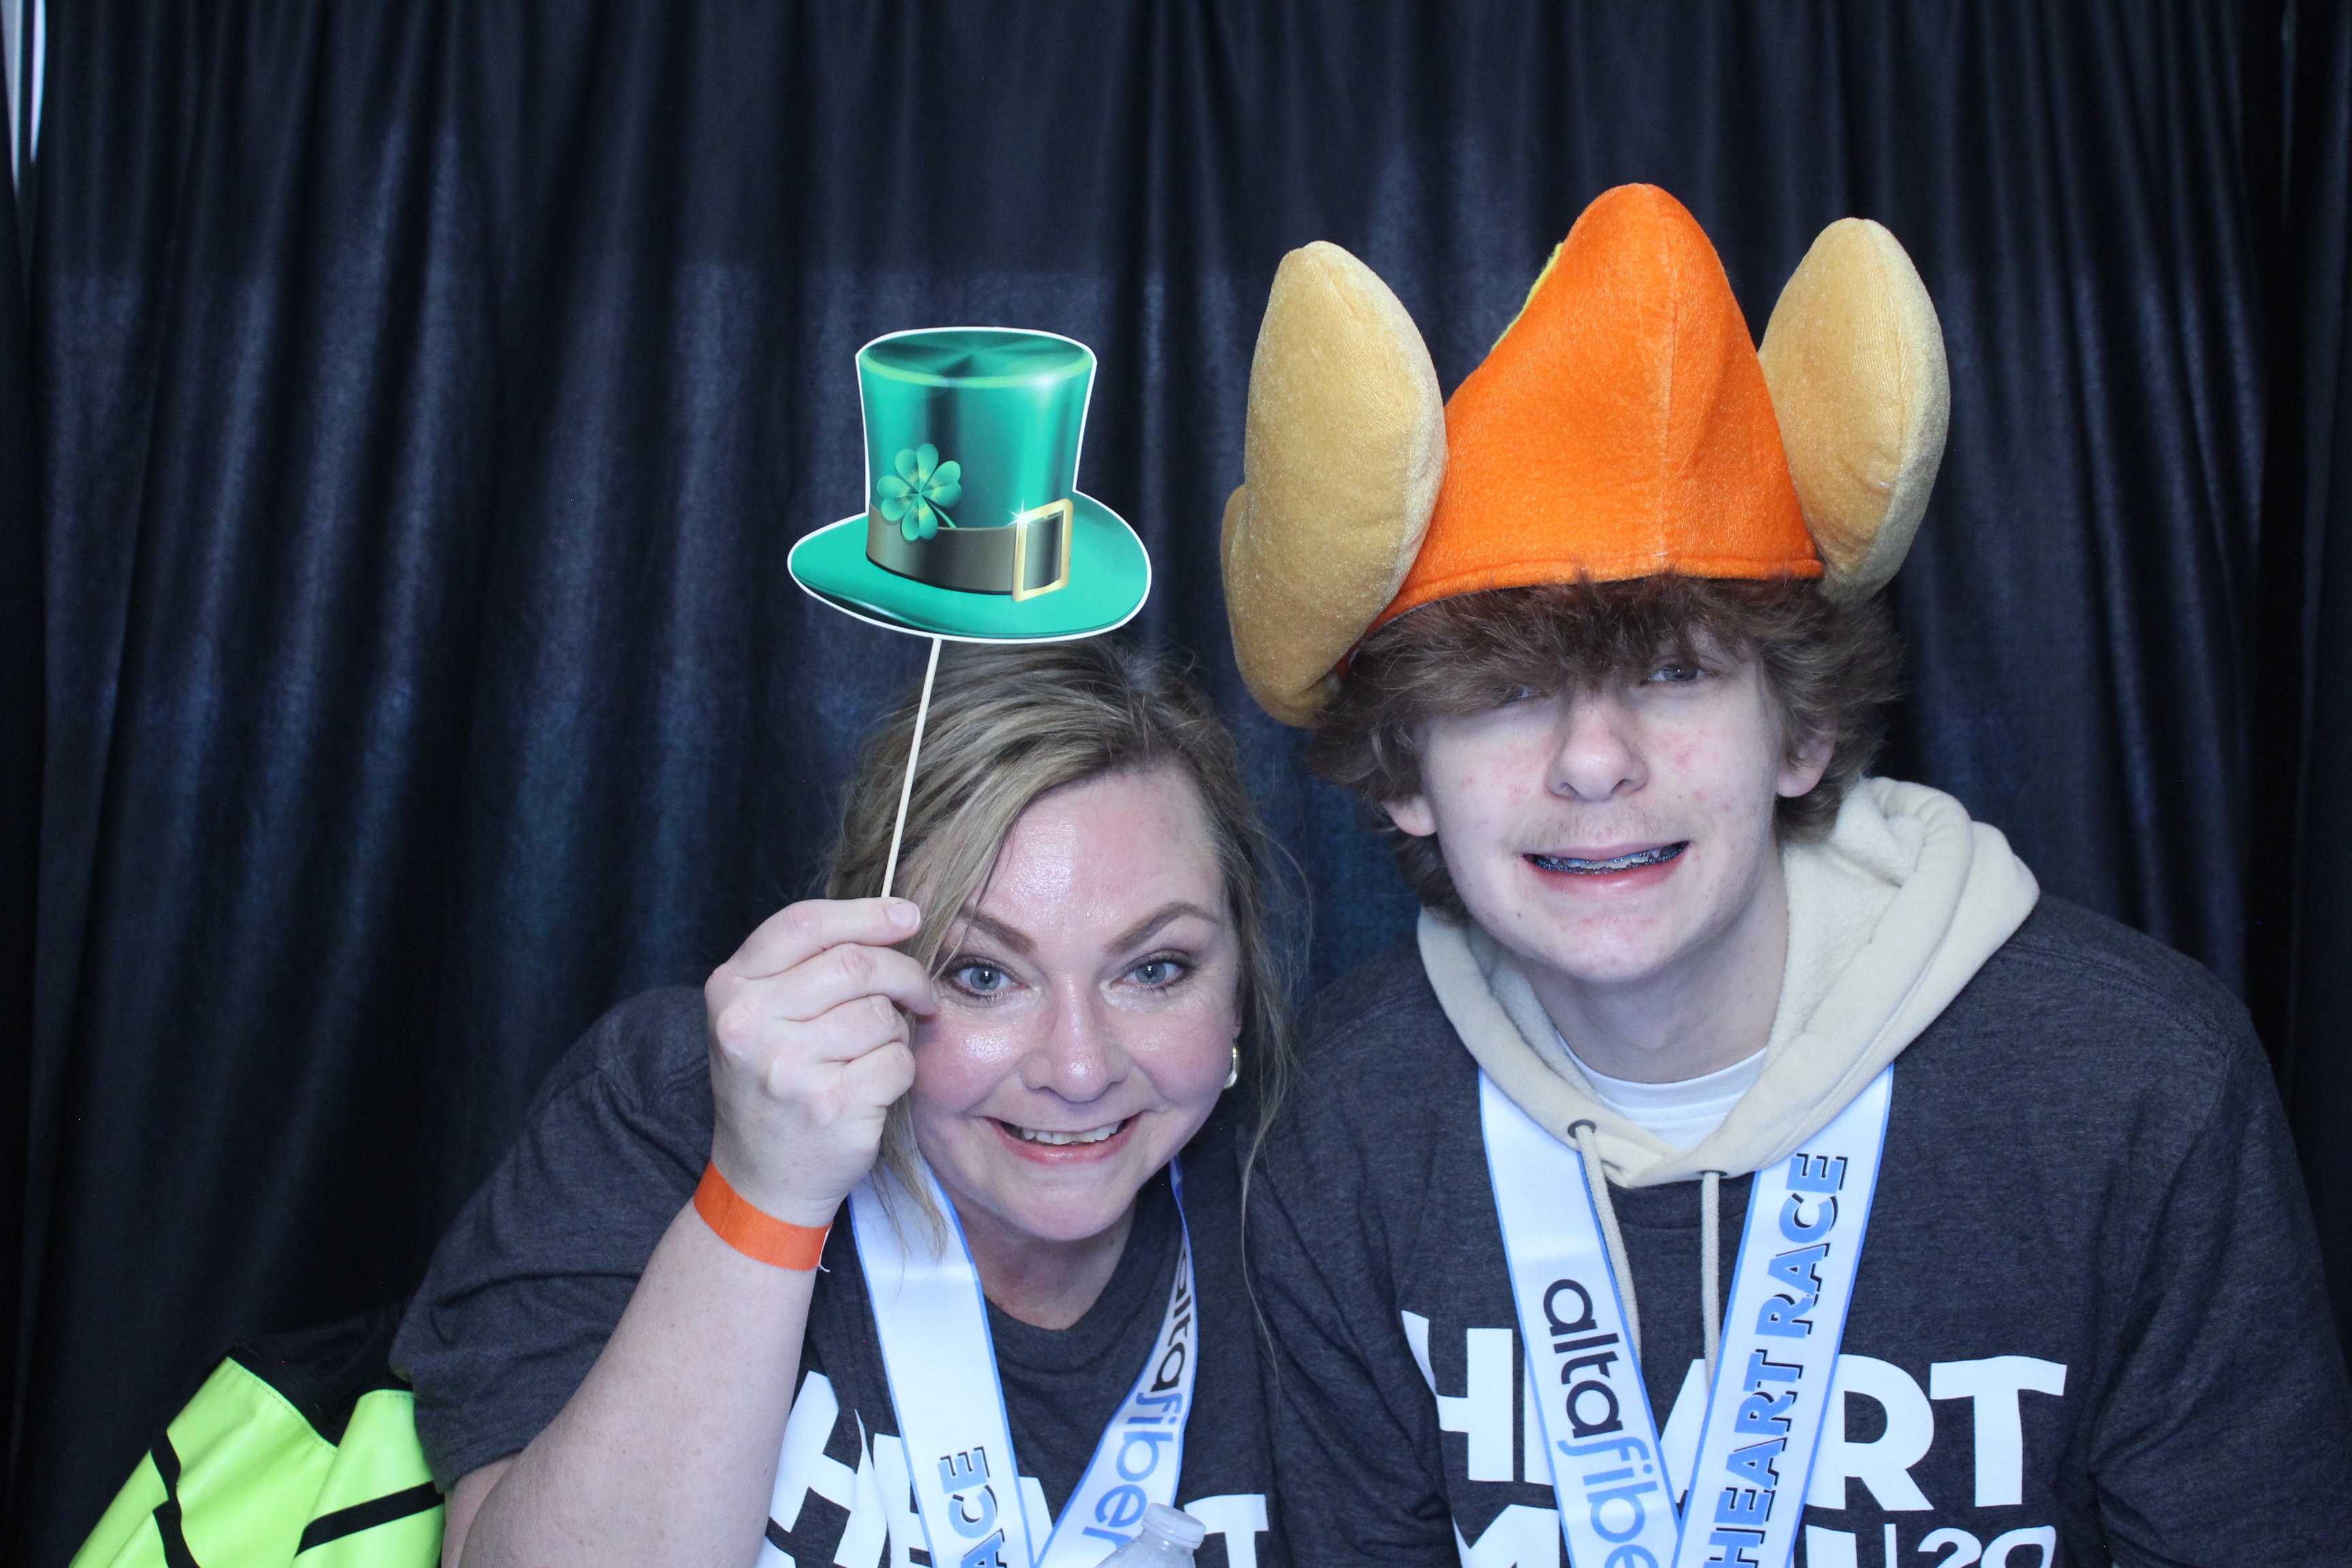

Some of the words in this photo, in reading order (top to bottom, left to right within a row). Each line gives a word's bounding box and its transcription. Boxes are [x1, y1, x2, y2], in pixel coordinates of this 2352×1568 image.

[1401, 1309, 2067, 1511] HRT
[1703, 1349, 1804, 1568] HEART
[1755, 1153, 1848, 1339] RACE
